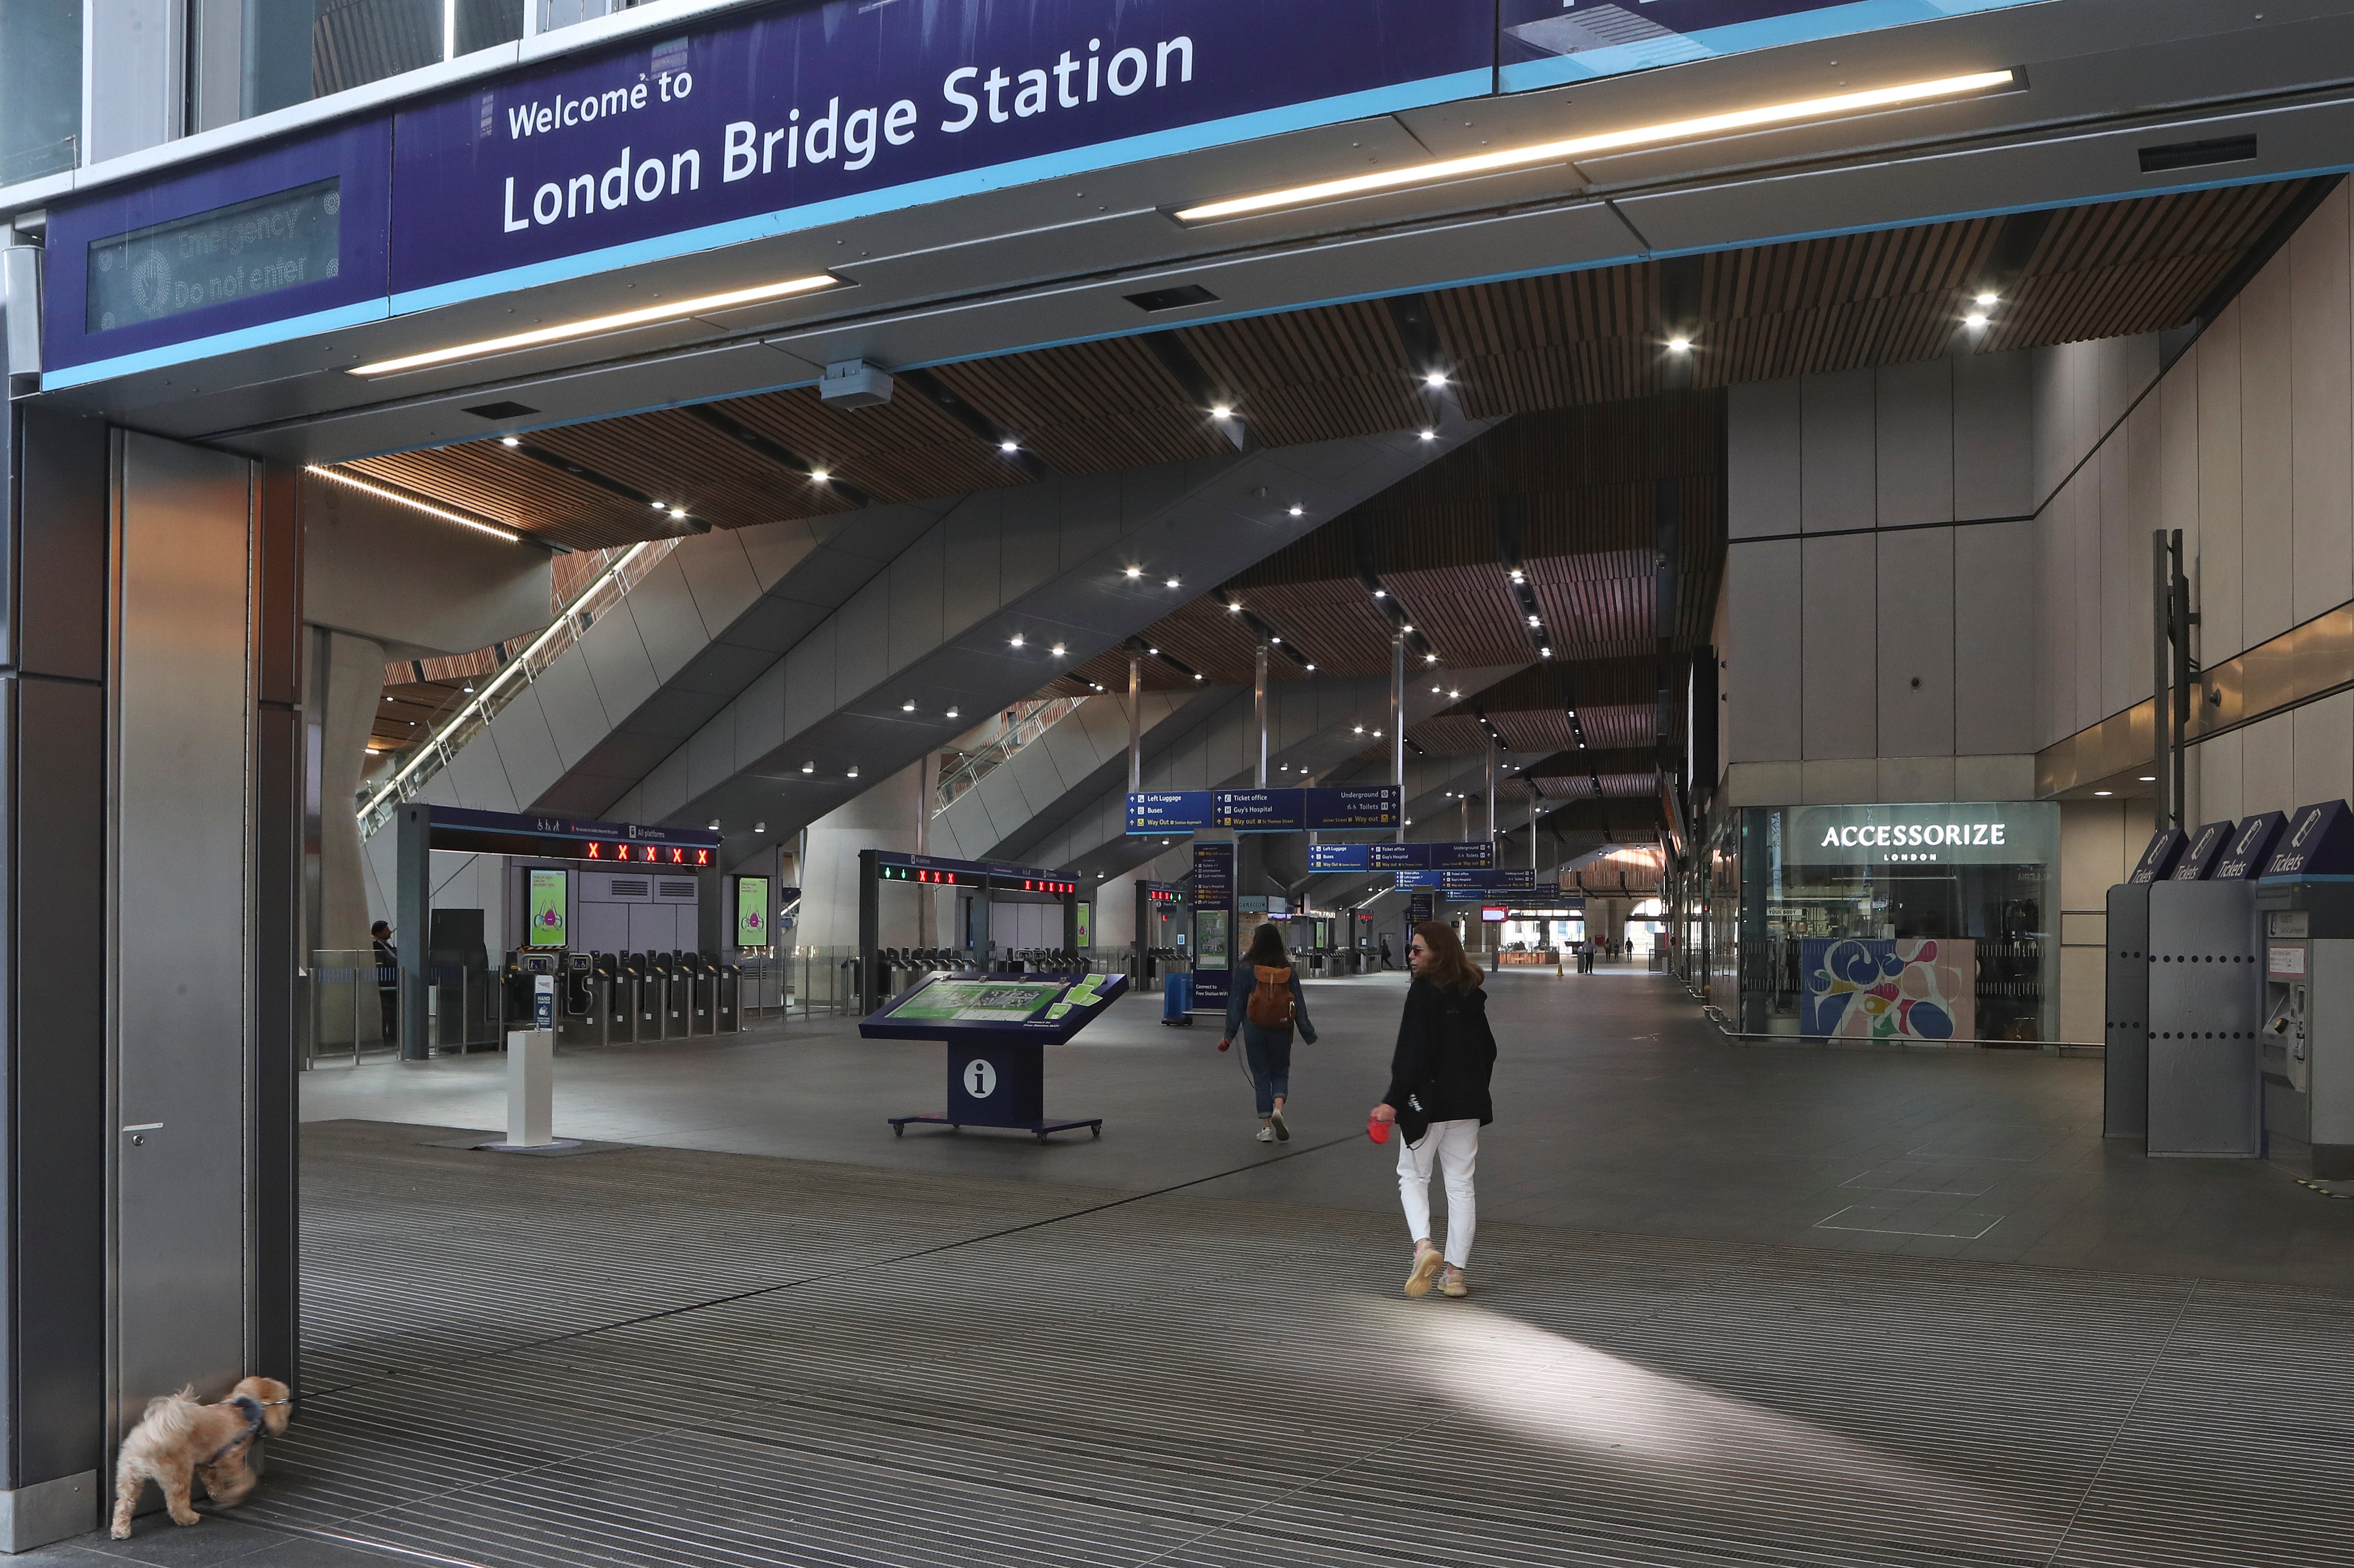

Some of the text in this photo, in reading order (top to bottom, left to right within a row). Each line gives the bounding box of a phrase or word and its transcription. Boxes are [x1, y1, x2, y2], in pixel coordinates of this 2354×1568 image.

[508, 72, 692, 139] Welcome to
[504, 36, 1193, 233] London Bridge Station
[178, 208, 298, 258] Emergency
[175, 256, 307, 308] Do not enter
[644, 829, 665, 838] platforms
[1821, 824, 2005, 847] ACCESSORIZE
[1883, 853, 1937, 861] LONDON
[2270, 852, 2304, 873] Tickets
[2131, 869, 2154, 884] Tickets
[2174, 865, 2199, 881] Tickets
[2217, 860, 2247, 878] Tickets
